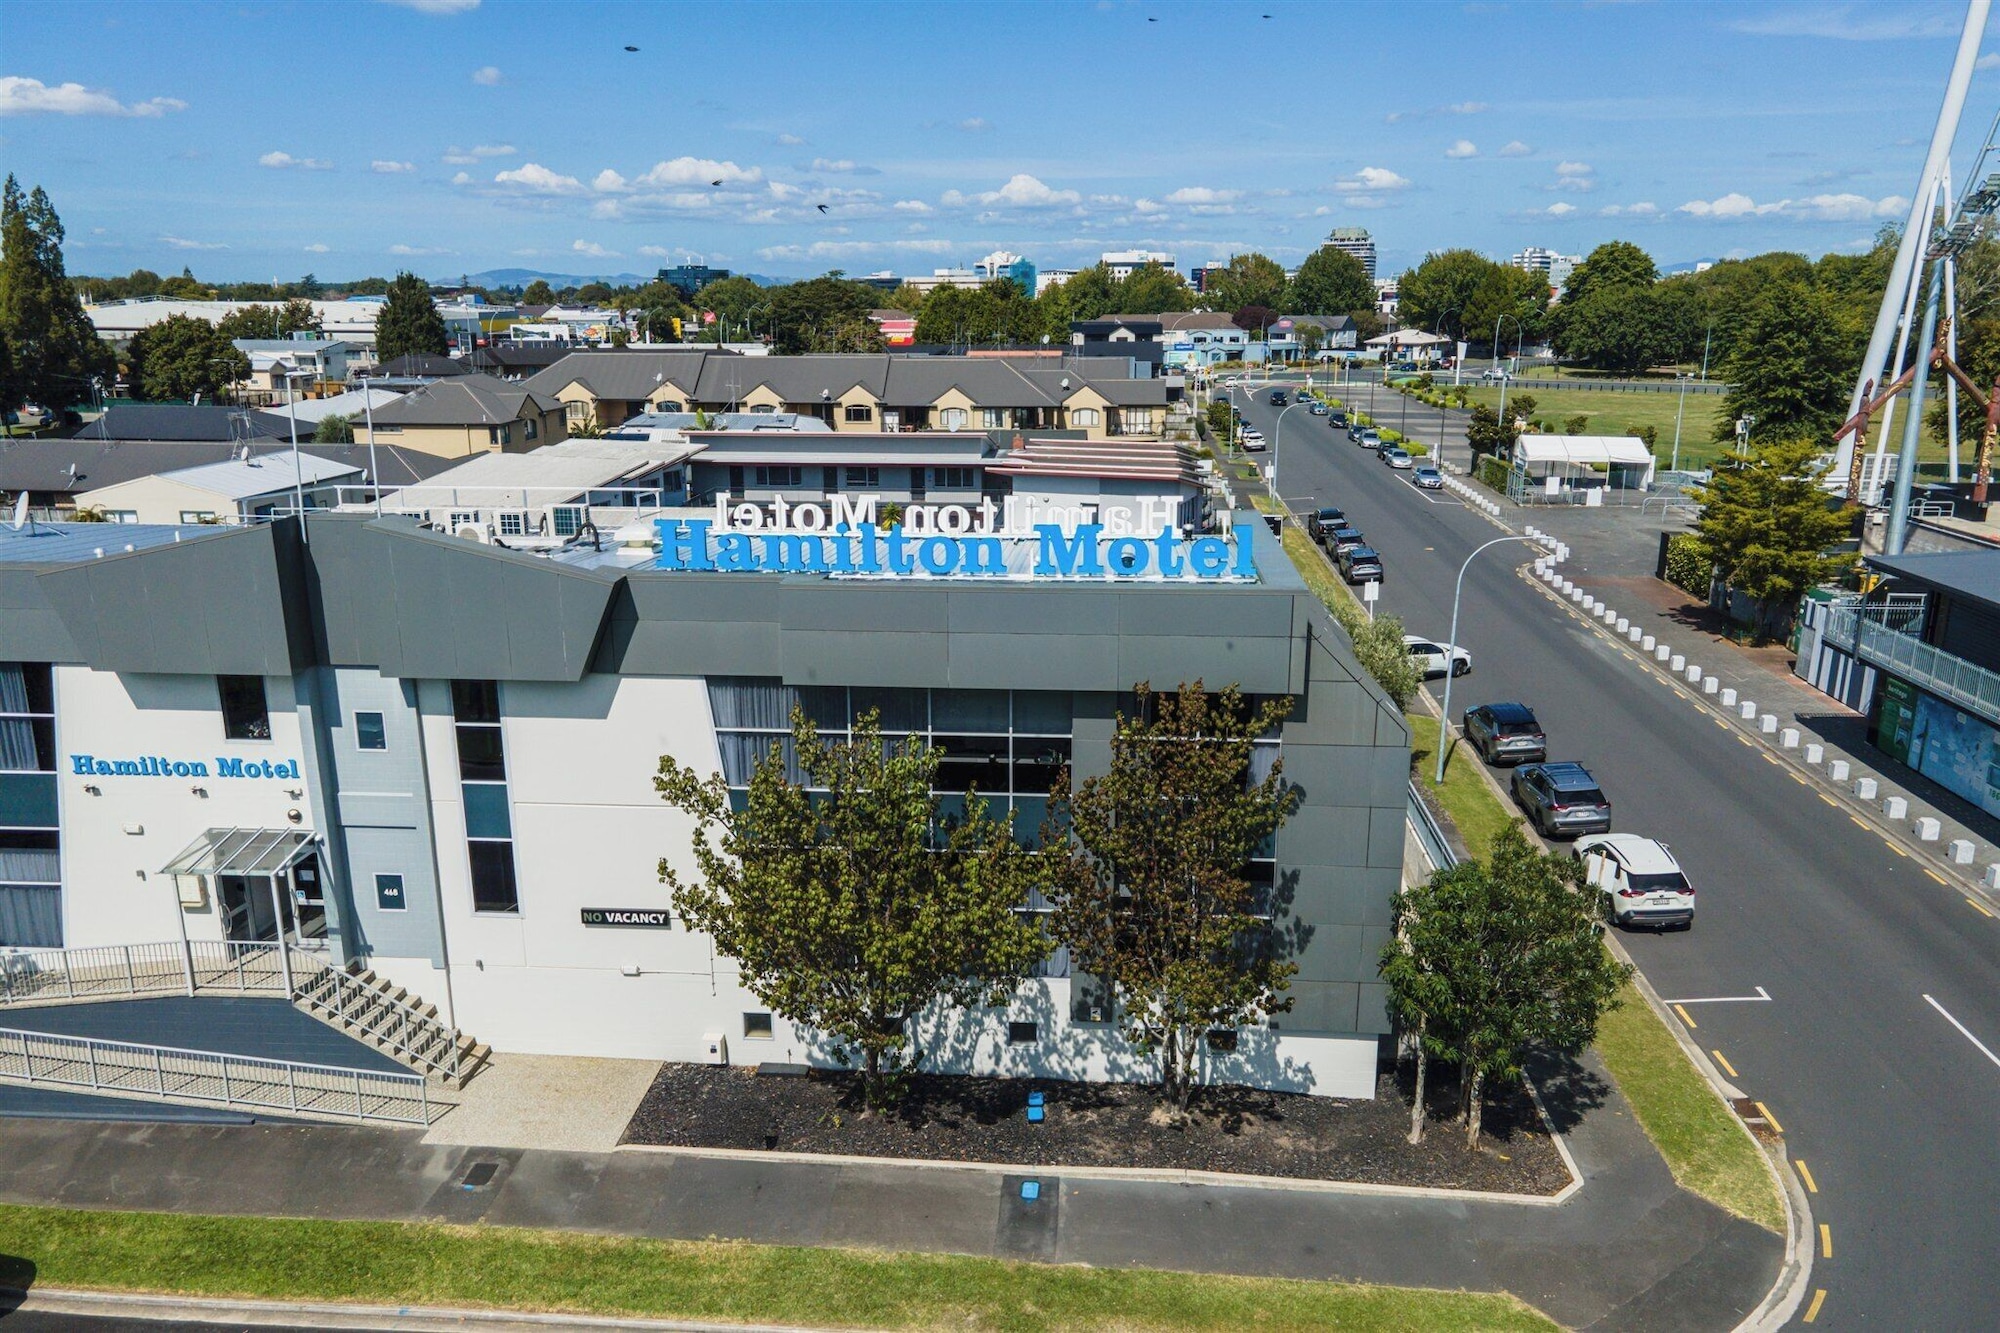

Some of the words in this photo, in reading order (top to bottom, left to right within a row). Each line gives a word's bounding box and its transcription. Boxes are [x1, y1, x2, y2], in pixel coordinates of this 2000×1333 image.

[655, 518, 1007, 575] Hamilton
[1034, 524, 1256, 576] Motel
[70, 755, 209, 777] Hamilton
[216, 757, 300, 779] Motel
[583, 912, 602, 922] NO
[605, 912, 666, 924] VACANCY
